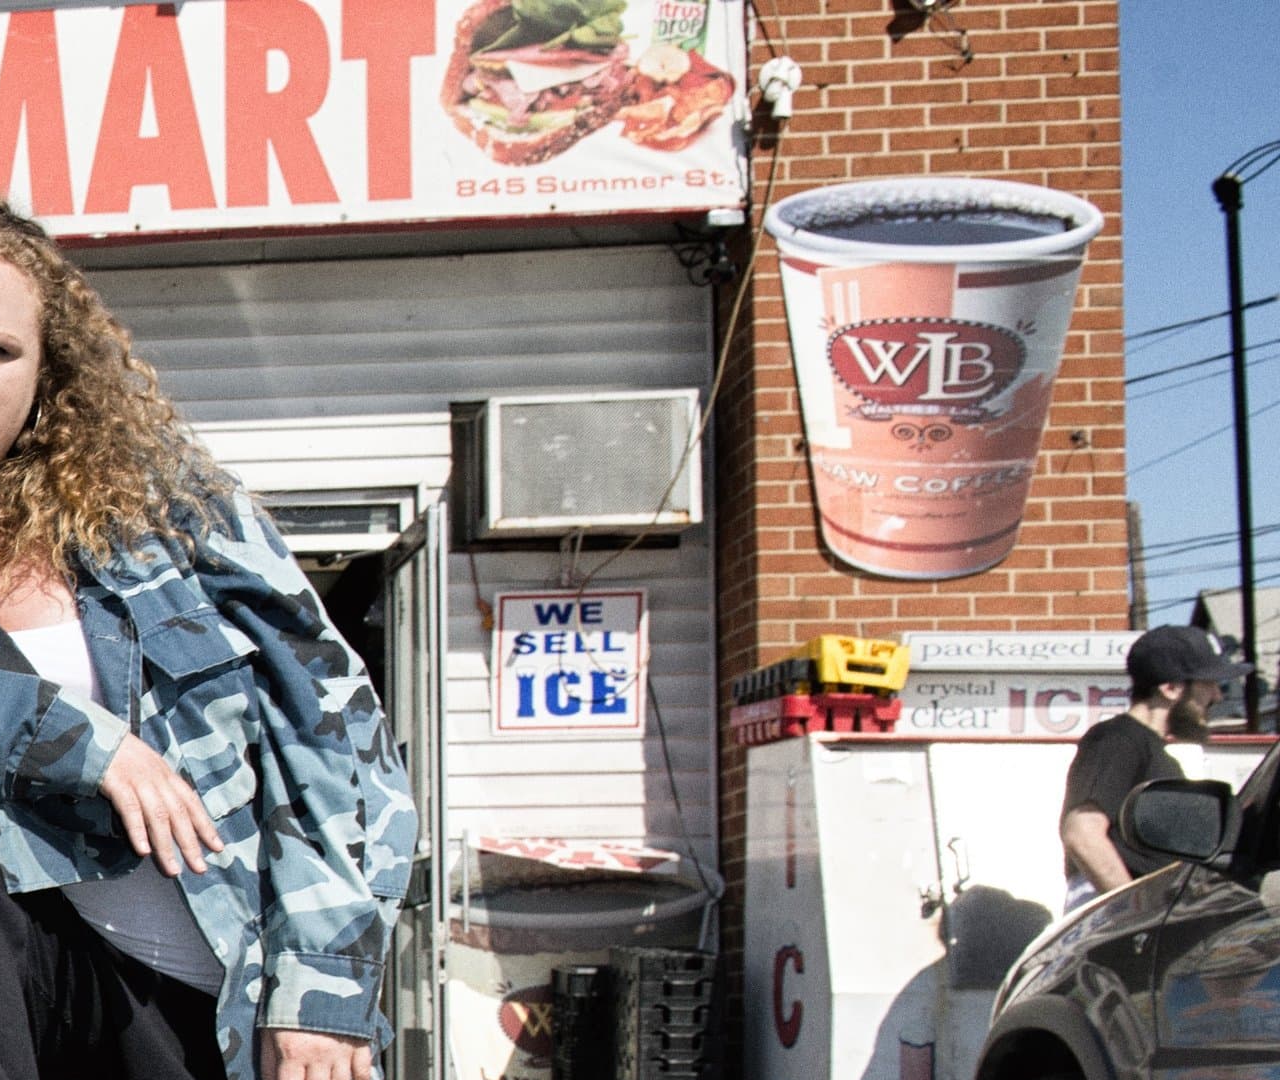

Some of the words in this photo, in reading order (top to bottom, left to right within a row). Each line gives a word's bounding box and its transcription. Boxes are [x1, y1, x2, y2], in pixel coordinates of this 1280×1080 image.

[456, 178, 525, 198] 845
[536, 174, 674, 195] Summer
[684, 168, 736, 188] St.
[534, 601, 603, 626] WE
[513, 630, 625, 656] SELL
[921, 638, 1093, 661] packaged
[516, 666, 628, 718] ICE
[916, 679, 996, 699] crystal
[910, 702, 999, 729] clear
[1008, 684, 1133, 735] ICE
